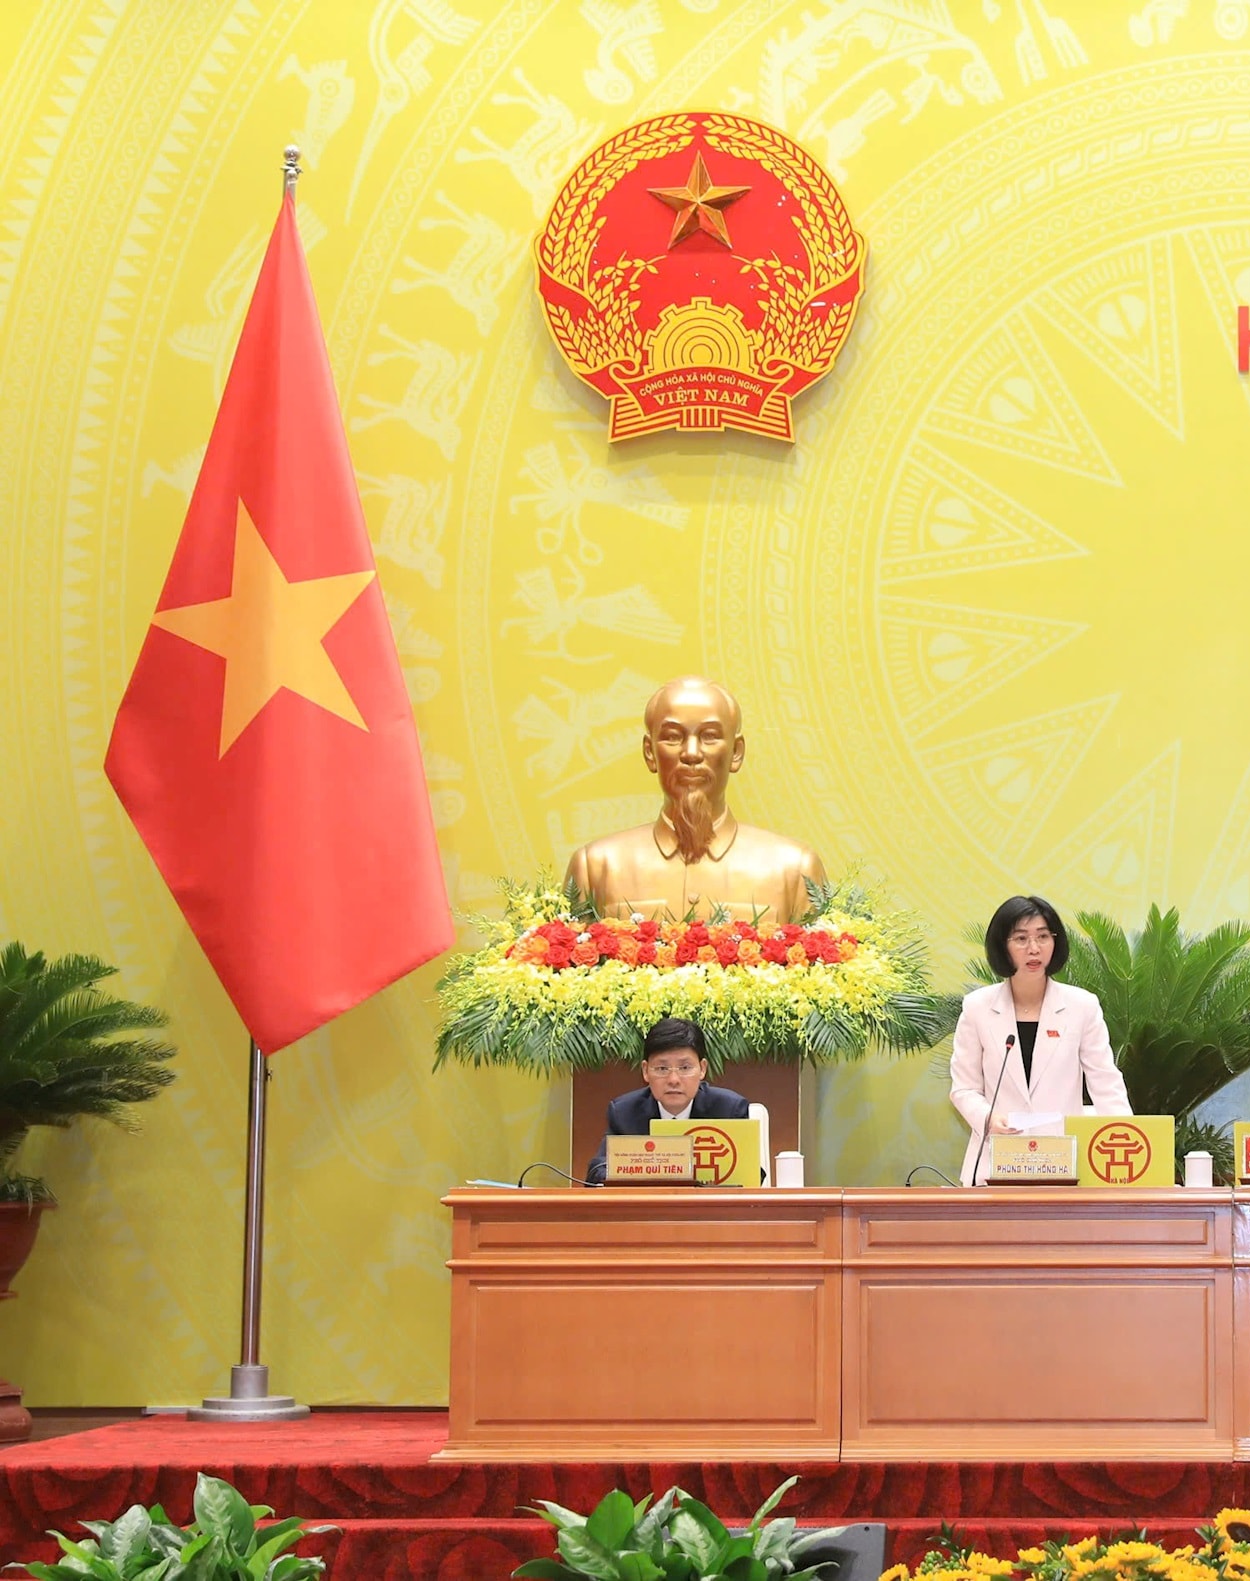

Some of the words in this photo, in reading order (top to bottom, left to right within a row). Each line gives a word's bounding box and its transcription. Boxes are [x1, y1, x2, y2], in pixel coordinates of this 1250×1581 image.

[640, 380, 664, 396] CỘNG
[686, 373, 699, 382] XÃ
[700, 371, 716, 384] HỘI
[737, 379, 764, 397] NGHĨA
[653, 386, 699, 406] VIỆT
[703, 388, 750, 407] NAM
[616, 1166, 643, 1175] PHẠM
